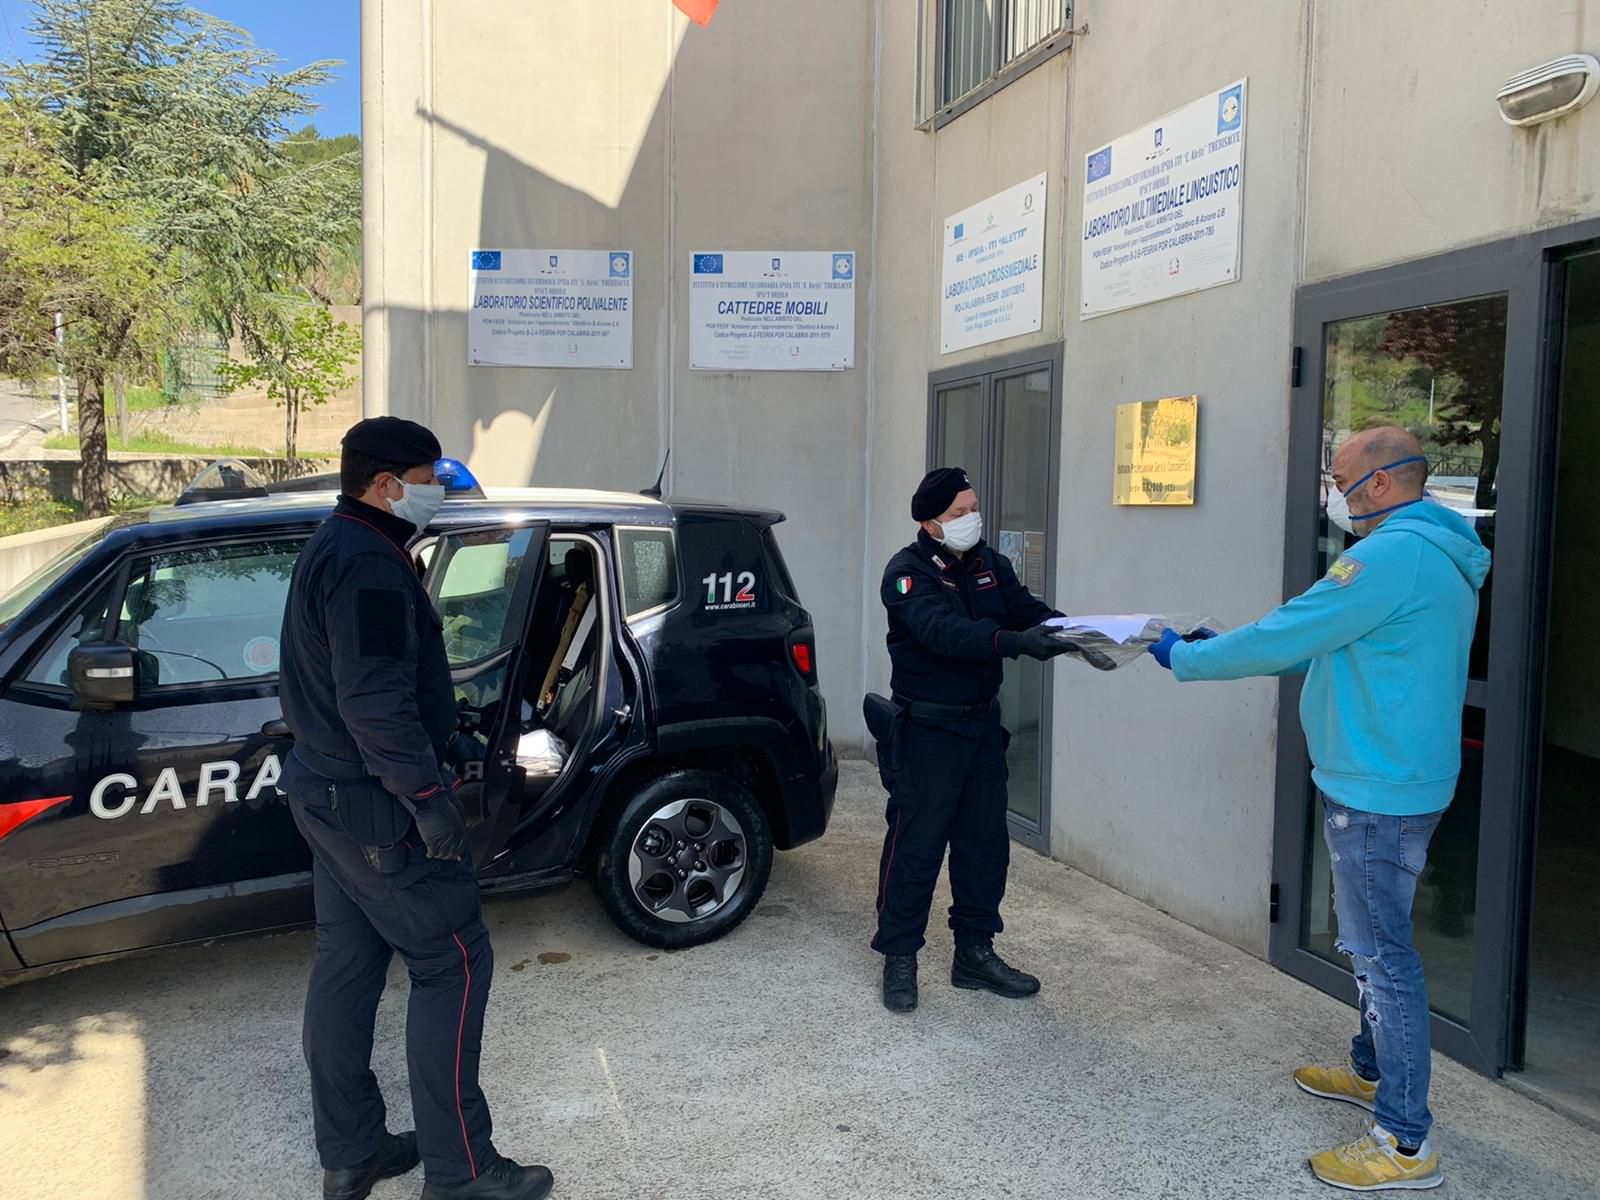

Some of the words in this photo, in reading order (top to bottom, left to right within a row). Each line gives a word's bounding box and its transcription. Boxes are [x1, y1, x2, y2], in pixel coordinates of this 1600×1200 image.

[1083, 204, 1130, 240] LABORATORIO
[1131, 186, 1184, 224] MULTIMEDIALE
[1185, 164, 1240, 202] LINGUISTICO
[474, 295, 527, 309] LABORATORIO
[528, 296, 575, 310] SCIENTIFICO
[576, 297, 628, 311] POLIVALENTE
[718, 300, 782, 315] CATTEDRE
[785, 301, 828, 316] MOBILI
[702, 571, 756, 603] 112
[705, 602, 756, 610] www.carabinieri.it
